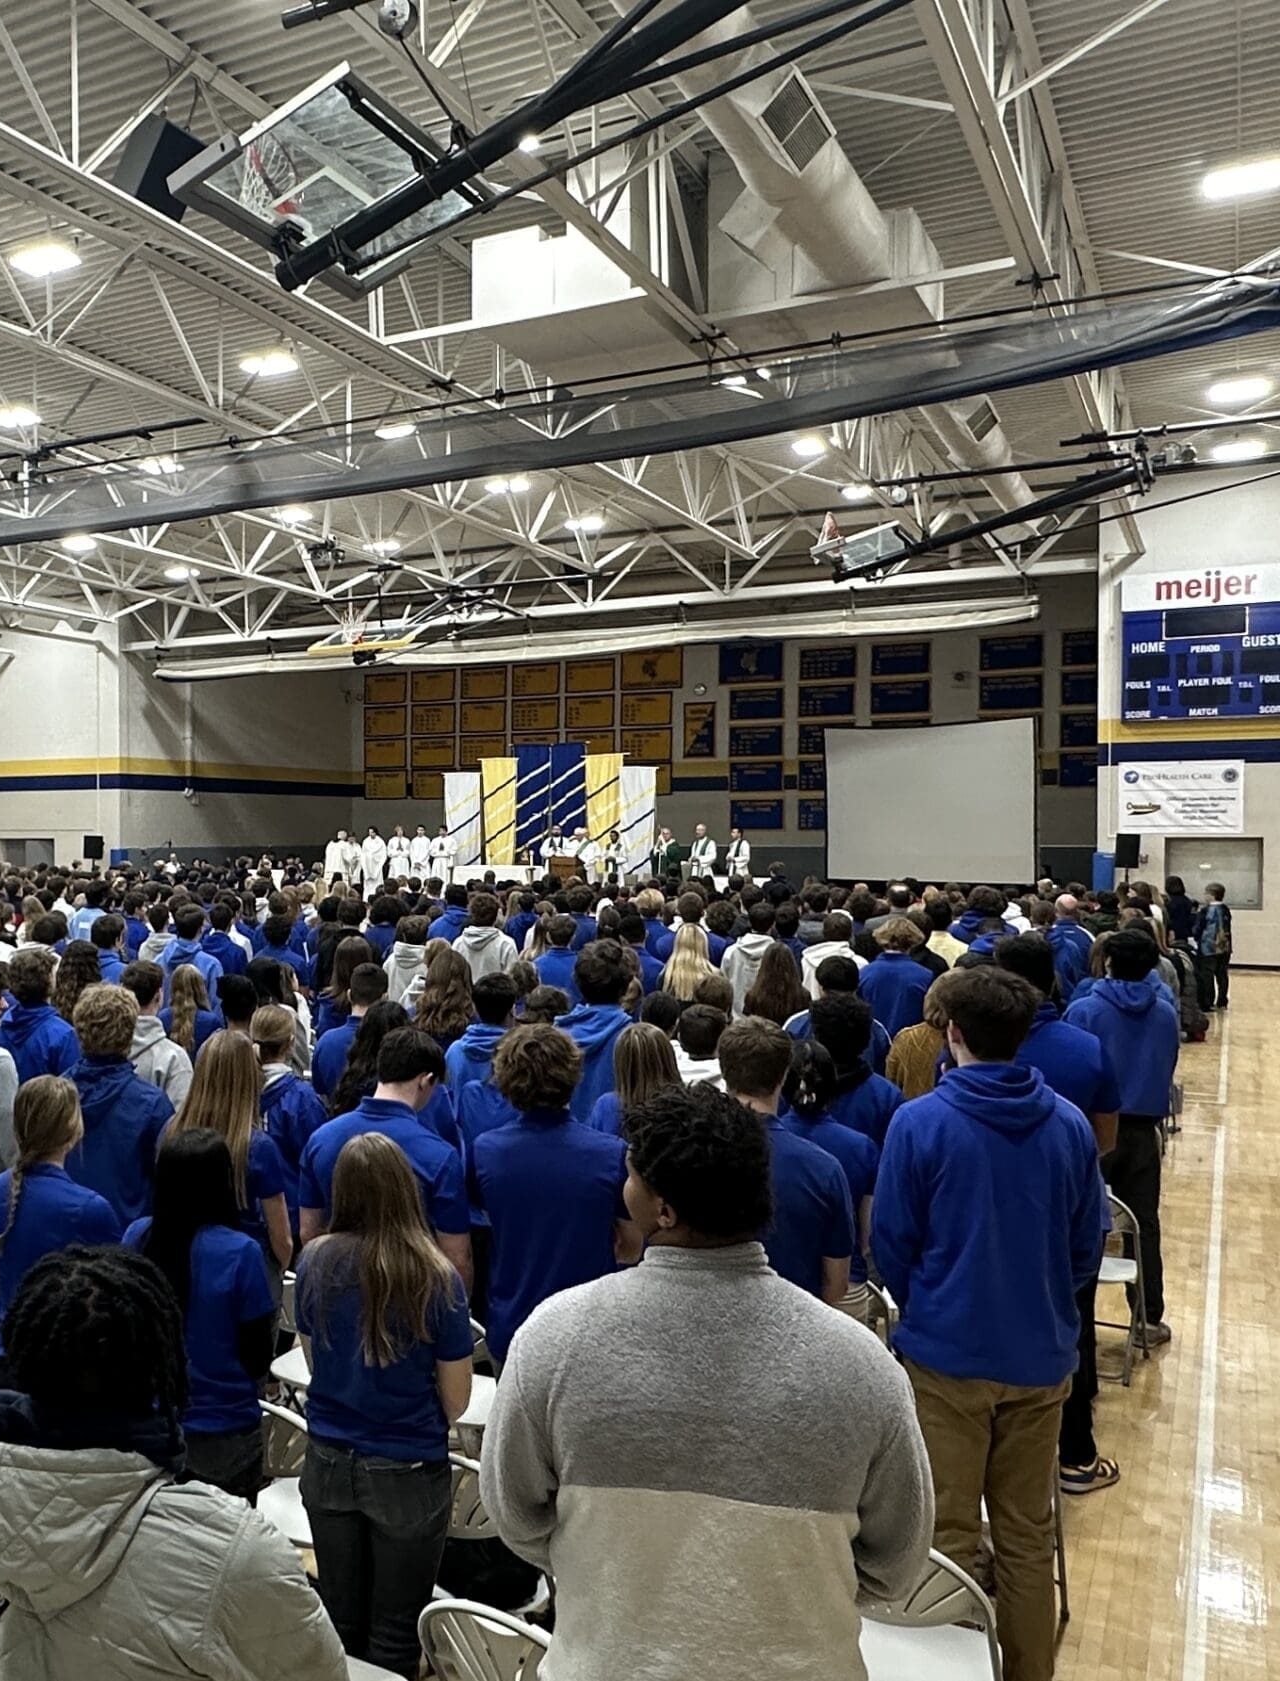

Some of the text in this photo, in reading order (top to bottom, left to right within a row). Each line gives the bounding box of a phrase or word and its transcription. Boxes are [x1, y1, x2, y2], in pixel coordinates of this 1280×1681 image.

[1155, 570, 1257, 603] meijer
[1131, 642, 1166, 654] HOME
[1190, 644, 1220, 653] PERIOD
[1125, 680, 1151, 689] FOULS
[1177, 676, 1233, 688] PLAYER FOUL
[1124, 710, 1151, 719] SCORE
[1188, 707, 1218, 716] MATCH
